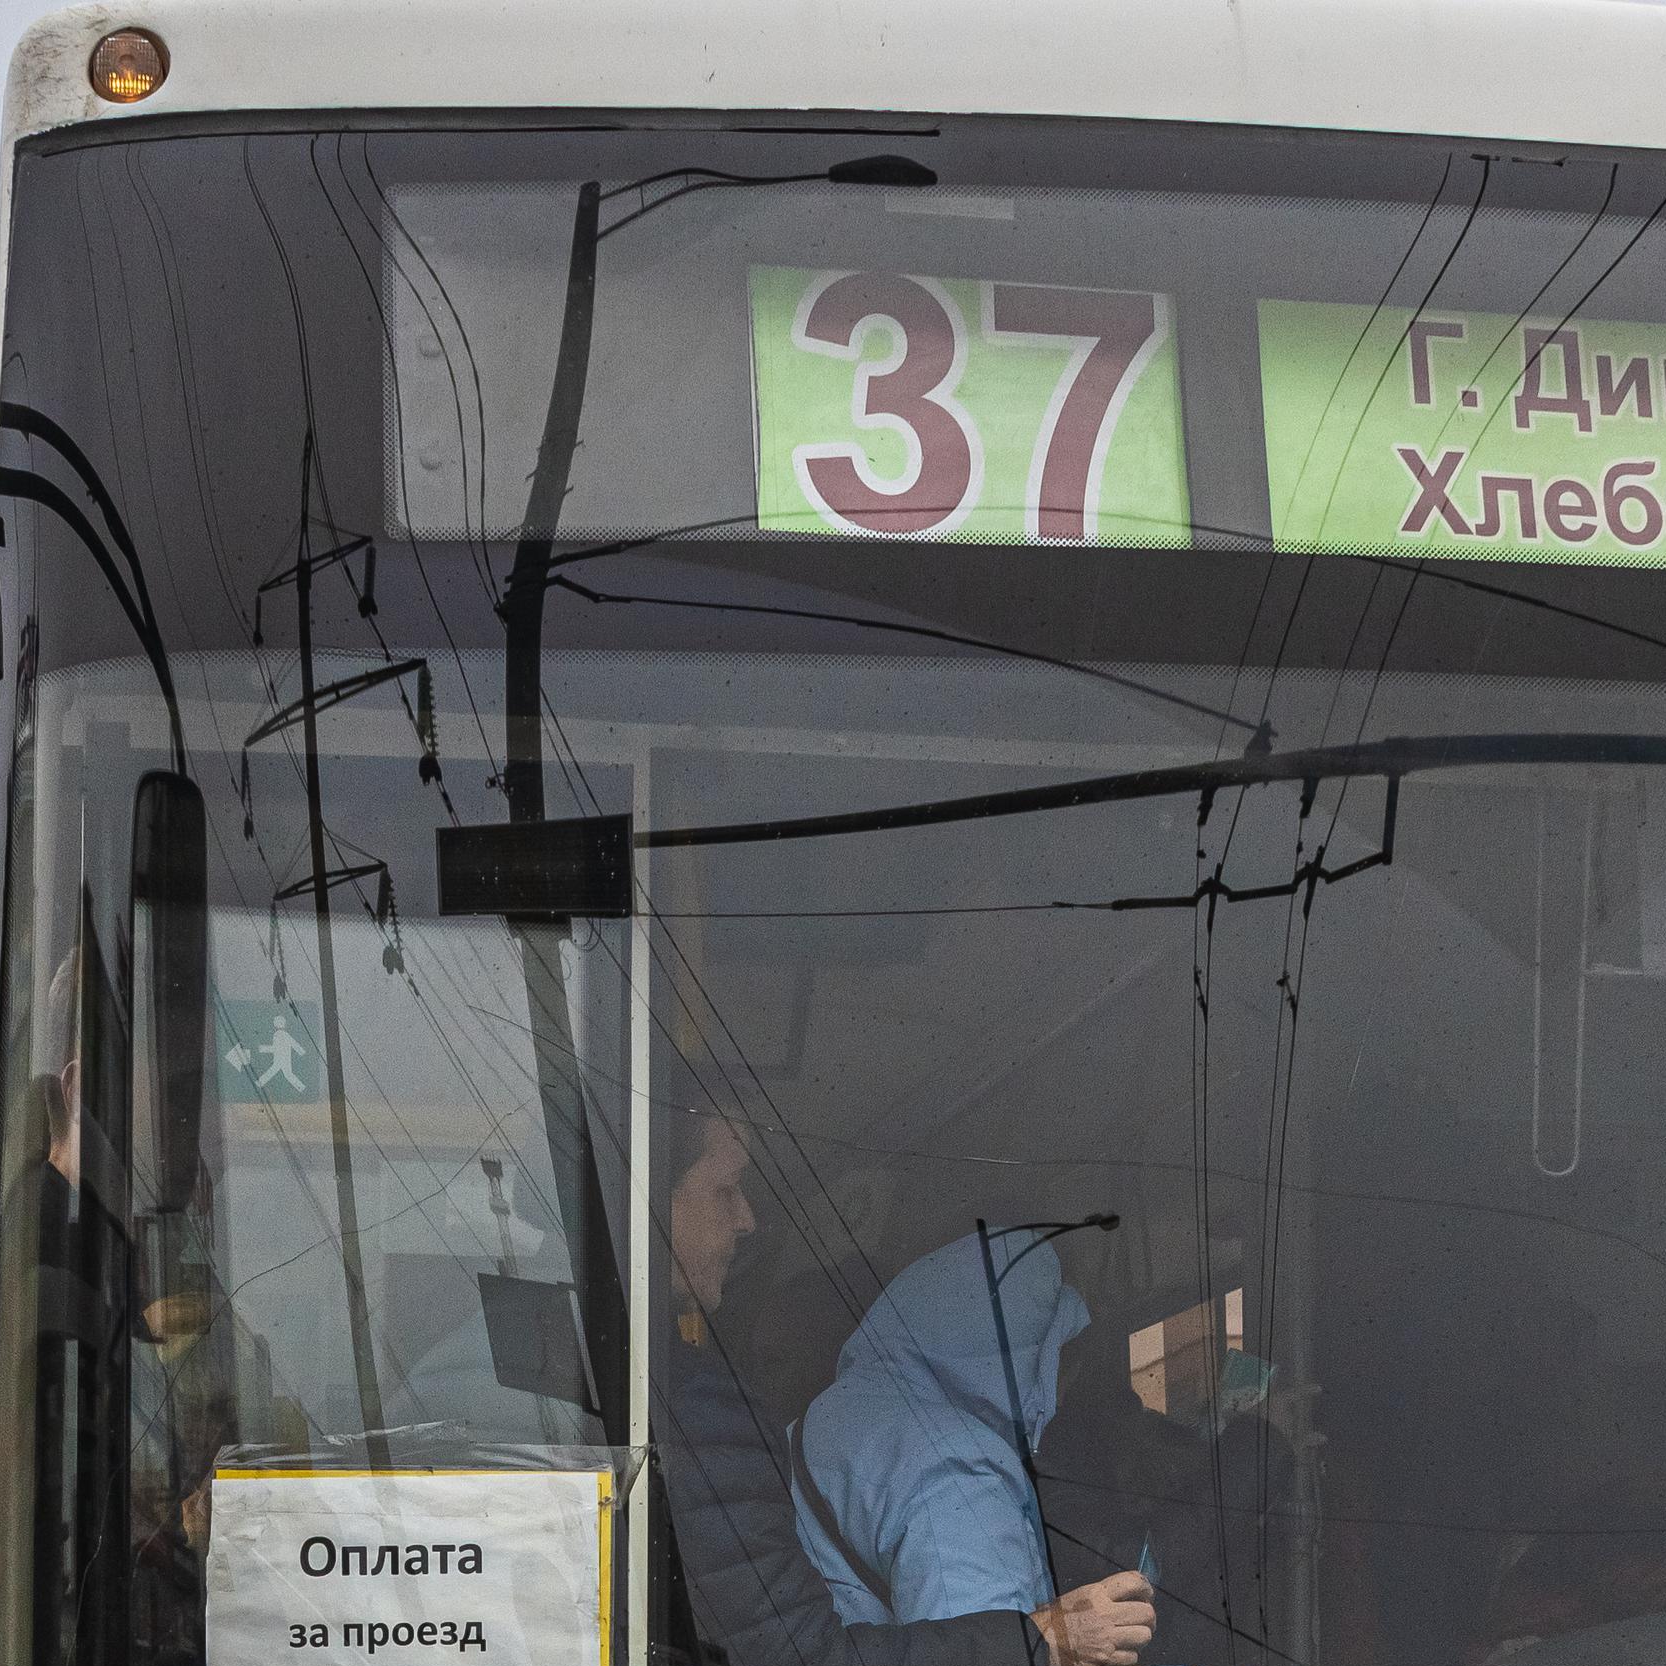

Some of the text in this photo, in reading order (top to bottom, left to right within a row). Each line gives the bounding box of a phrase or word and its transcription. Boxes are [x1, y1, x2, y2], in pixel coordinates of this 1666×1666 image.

[1409, 320, 1478, 408] Г.
[796, 270, 1166, 546] 37
[299, 1535, 484, 1578] Оплата
[288, 1617, 487, 1654] за проезд
